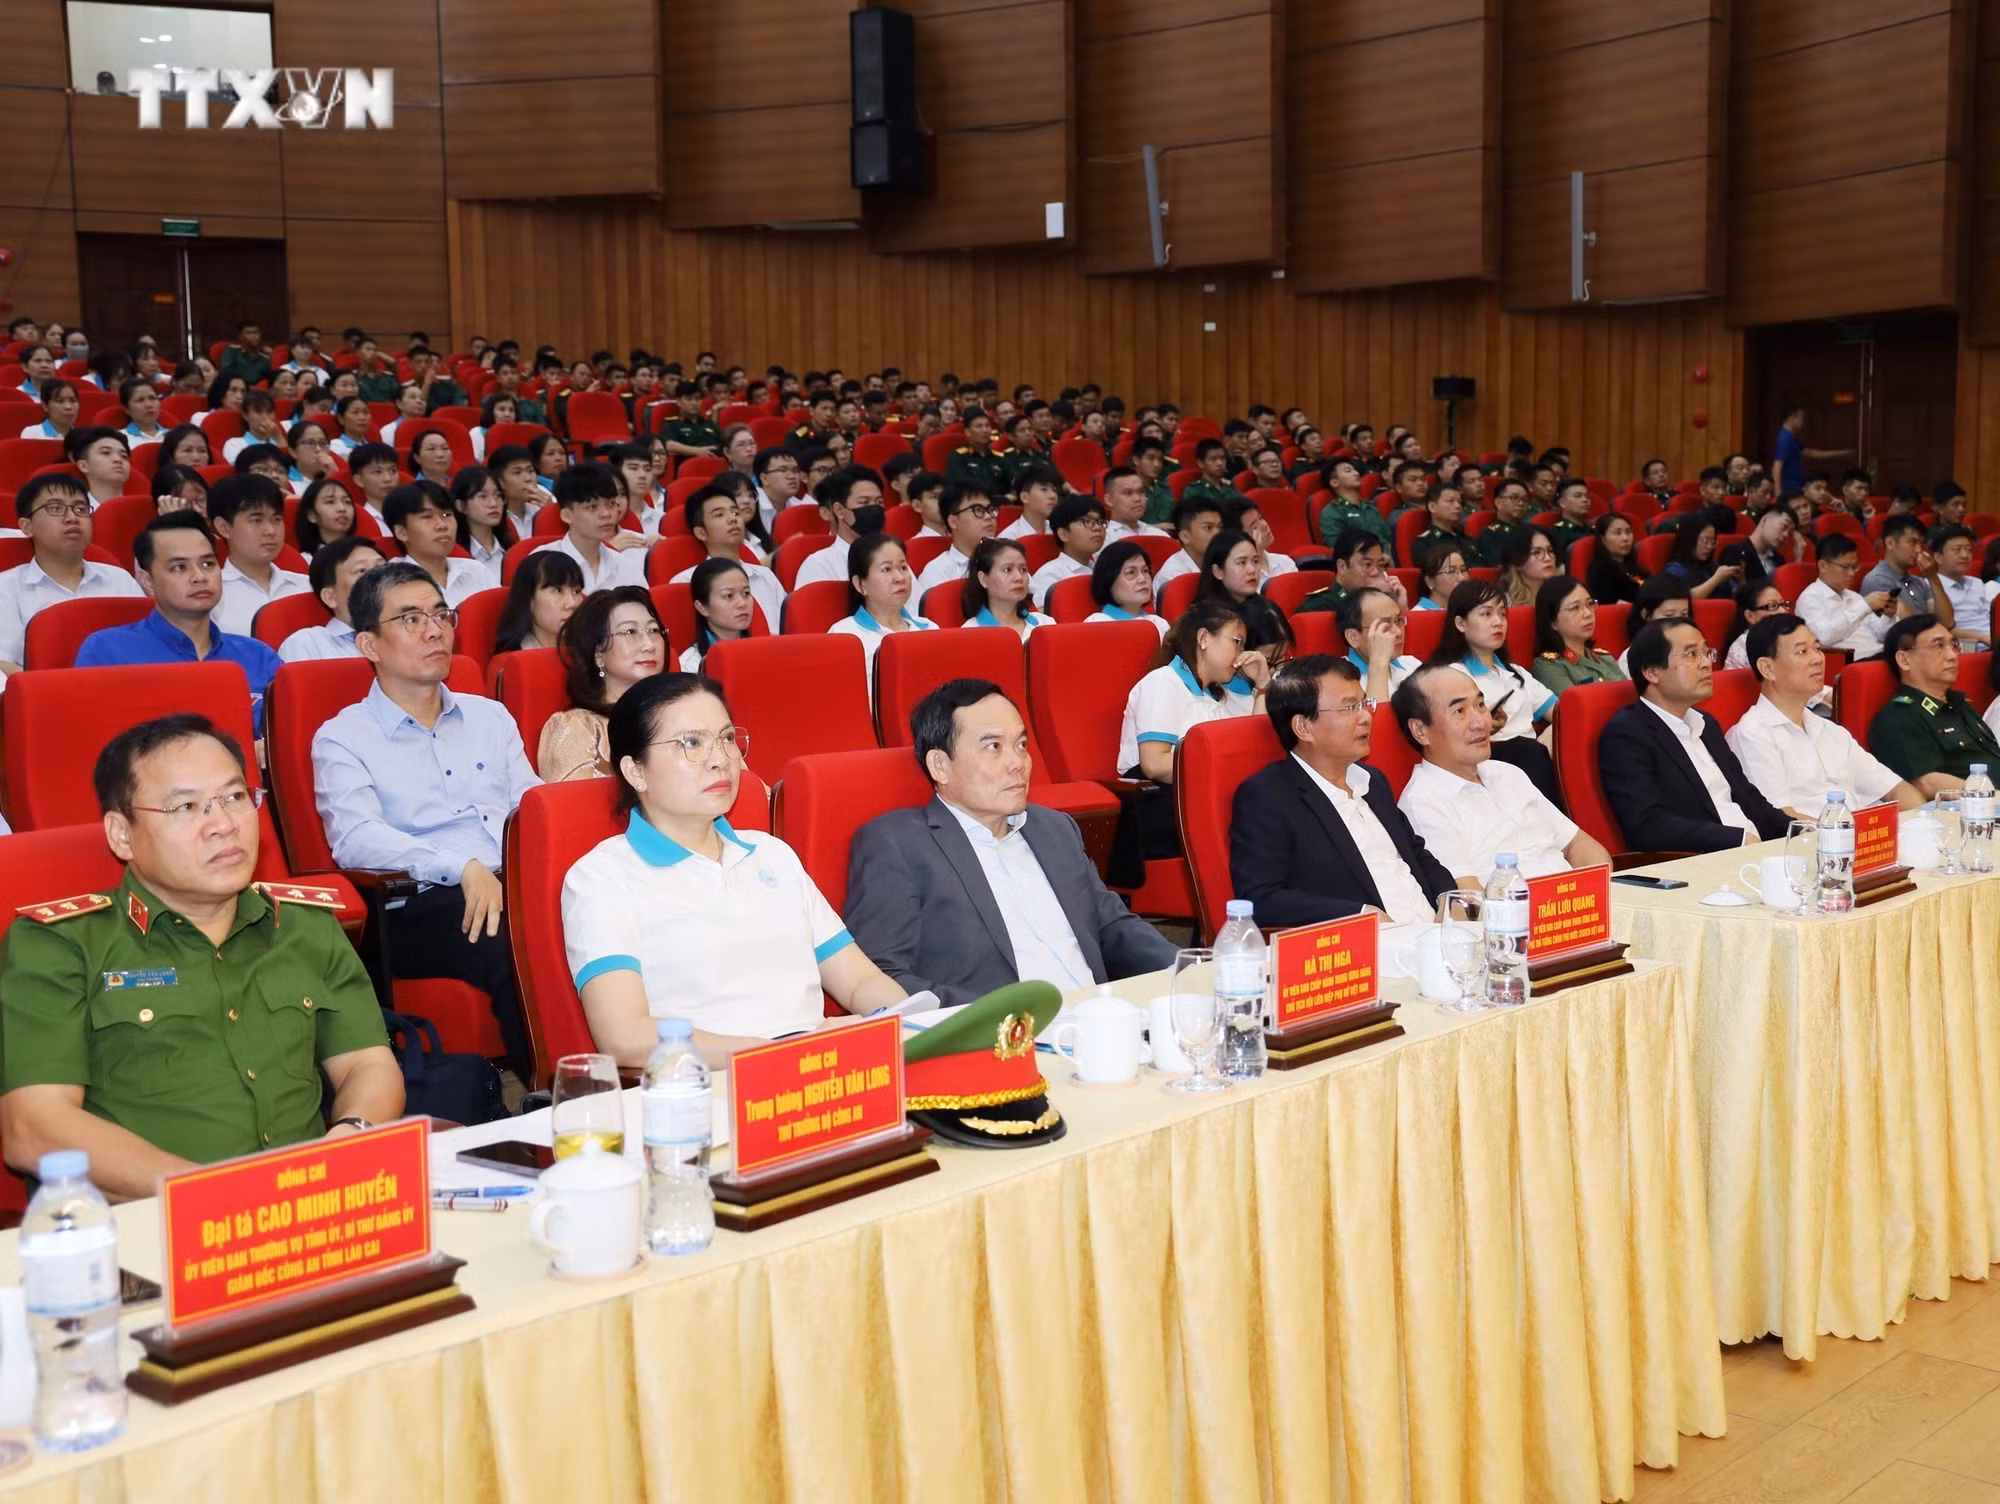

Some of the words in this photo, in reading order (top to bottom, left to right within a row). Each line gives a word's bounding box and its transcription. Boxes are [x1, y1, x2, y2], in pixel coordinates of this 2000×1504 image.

[1557, 899, 1571, 915] LƯU
[1572, 895, 1595, 912] QUANG
[1304, 955, 1316, 976] HÀ
[1318, 954, 1332, 973] THỊ
[1334, 950, 1351, 968] NGA
[745, 1099, 774, 1123] Trung
[775, 1089, 803, 1114] tướng
[804, 1070, 844, 1106] NGUYỄN
[845, 1069, 864, 1096] VĂN
[865, 1065, 890, 1090] LONG
[852, 1105, 863, 1121] AN
[308, 1161, 327, 1183] CHÍ
[202, 1216, 231, 1249] Đại
[235, 1210, 253, 1238] tá
[257, 1201, 292, 1232] CAO
[296, 1189, 341, 1223] MINH
[201, 1255, 224, 1277] VIÊN
[226, 1252, 248, 1271] BAN
[289, 1236, 302, 1255] VỤ
[227, 1274, 253, 1296] GIÁM
[277, 1259, 304, 1281] CÔNG
[306, 1254, 320, 1273] AN
[344, 1244, 362, 1264] LÀO
[364, 1240, 380, 1258] CAI
